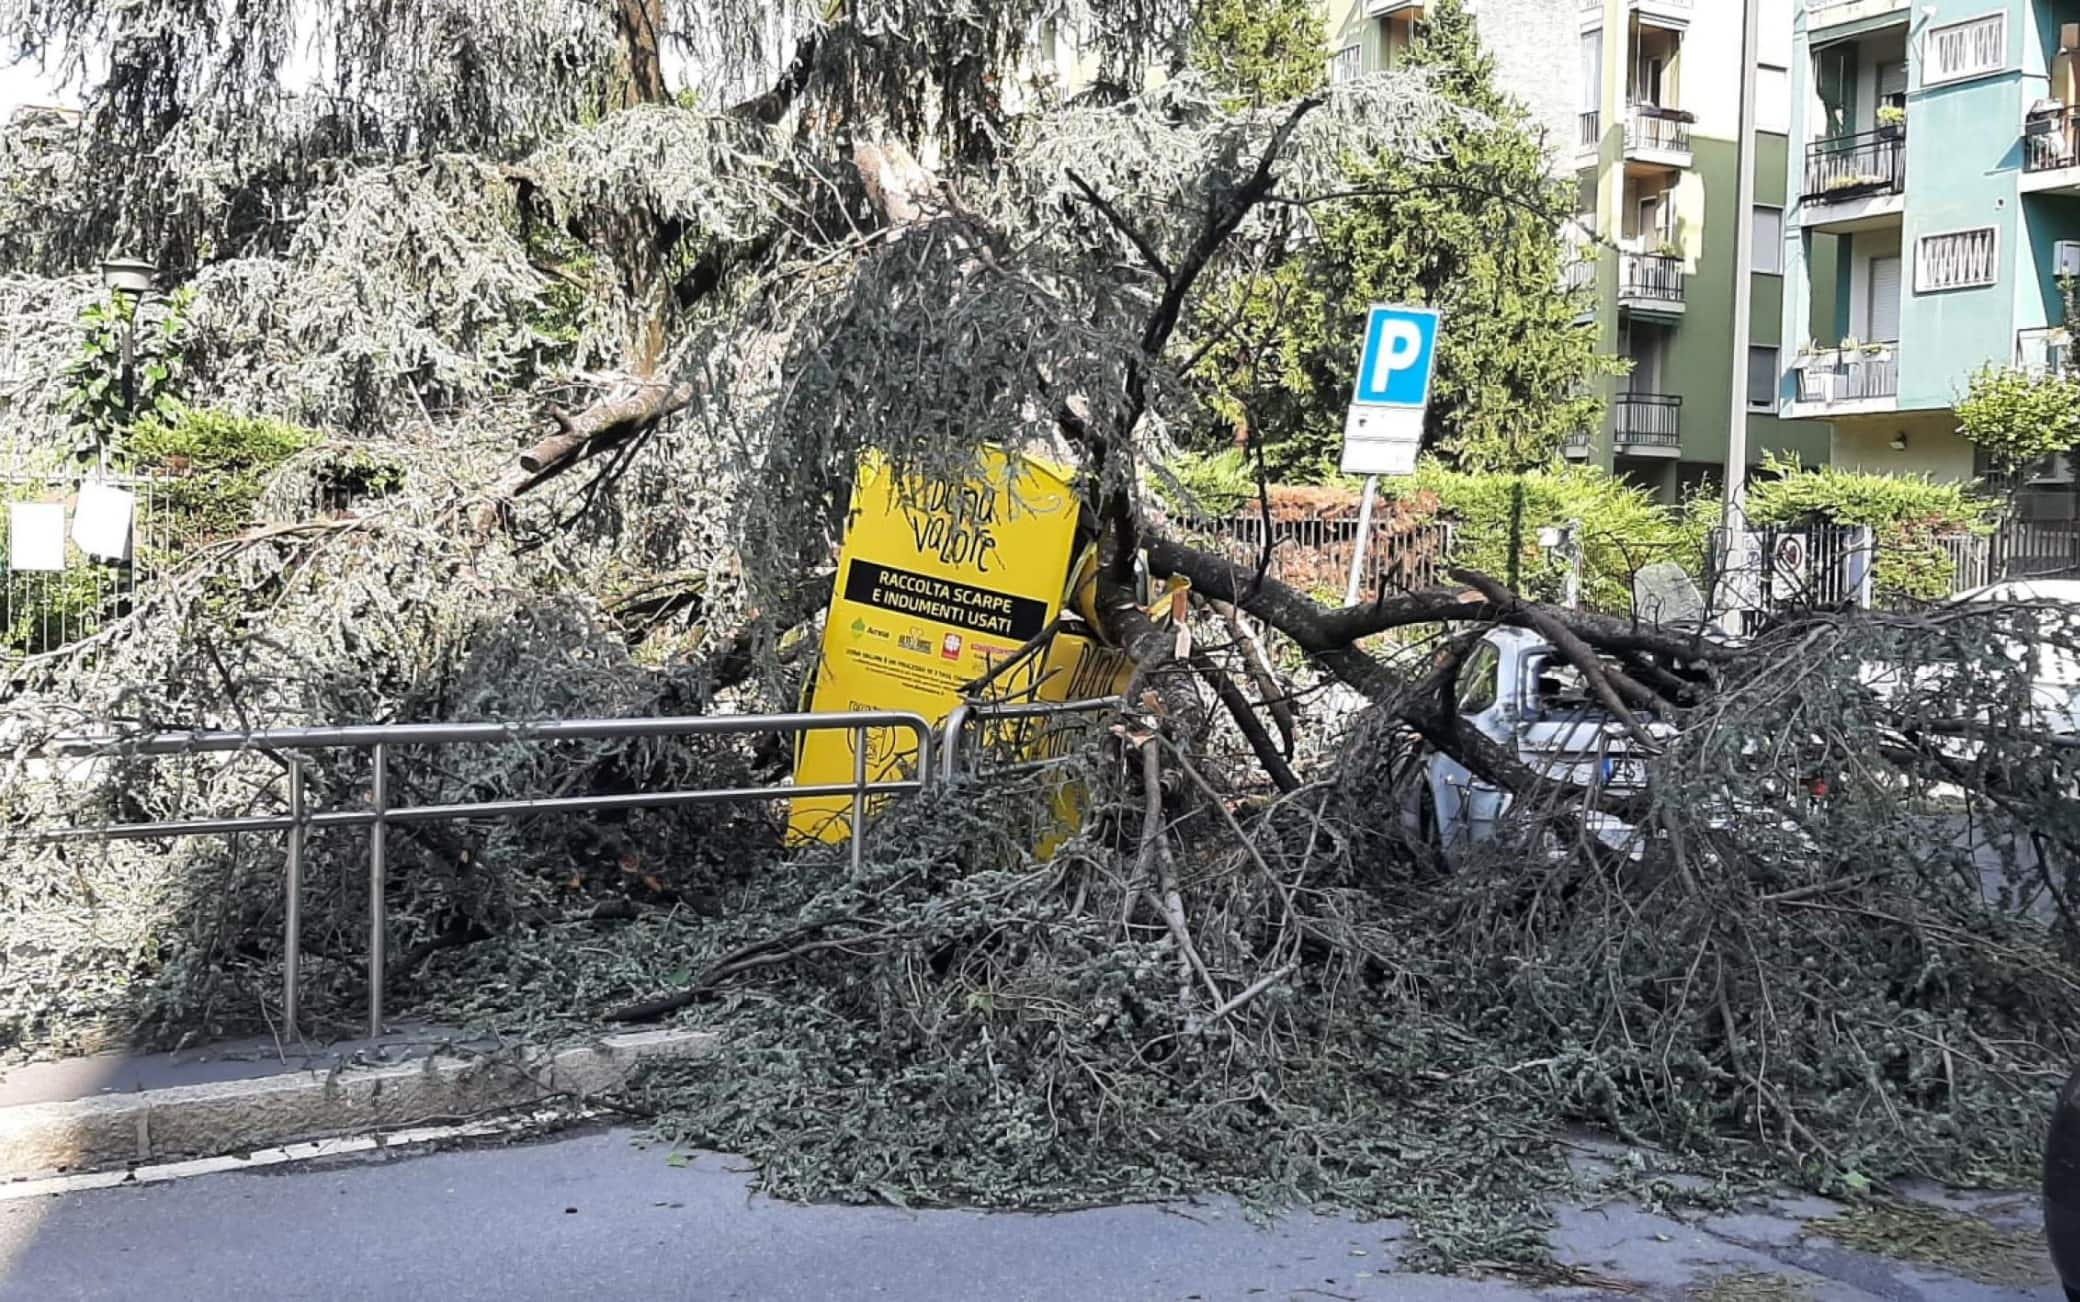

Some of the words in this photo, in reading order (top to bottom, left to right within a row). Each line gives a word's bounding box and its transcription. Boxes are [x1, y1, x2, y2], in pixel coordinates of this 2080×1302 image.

[1371, 319, 1422, 393] P
[871, 588, 882, 602] E
[884, 591, 965, 622] INDUMENTI
[967, 611, 1012, 634] USATI
[879, 570, 950, 600] RACCOLTA
[953, 588, 1013, 614] SCARPE
